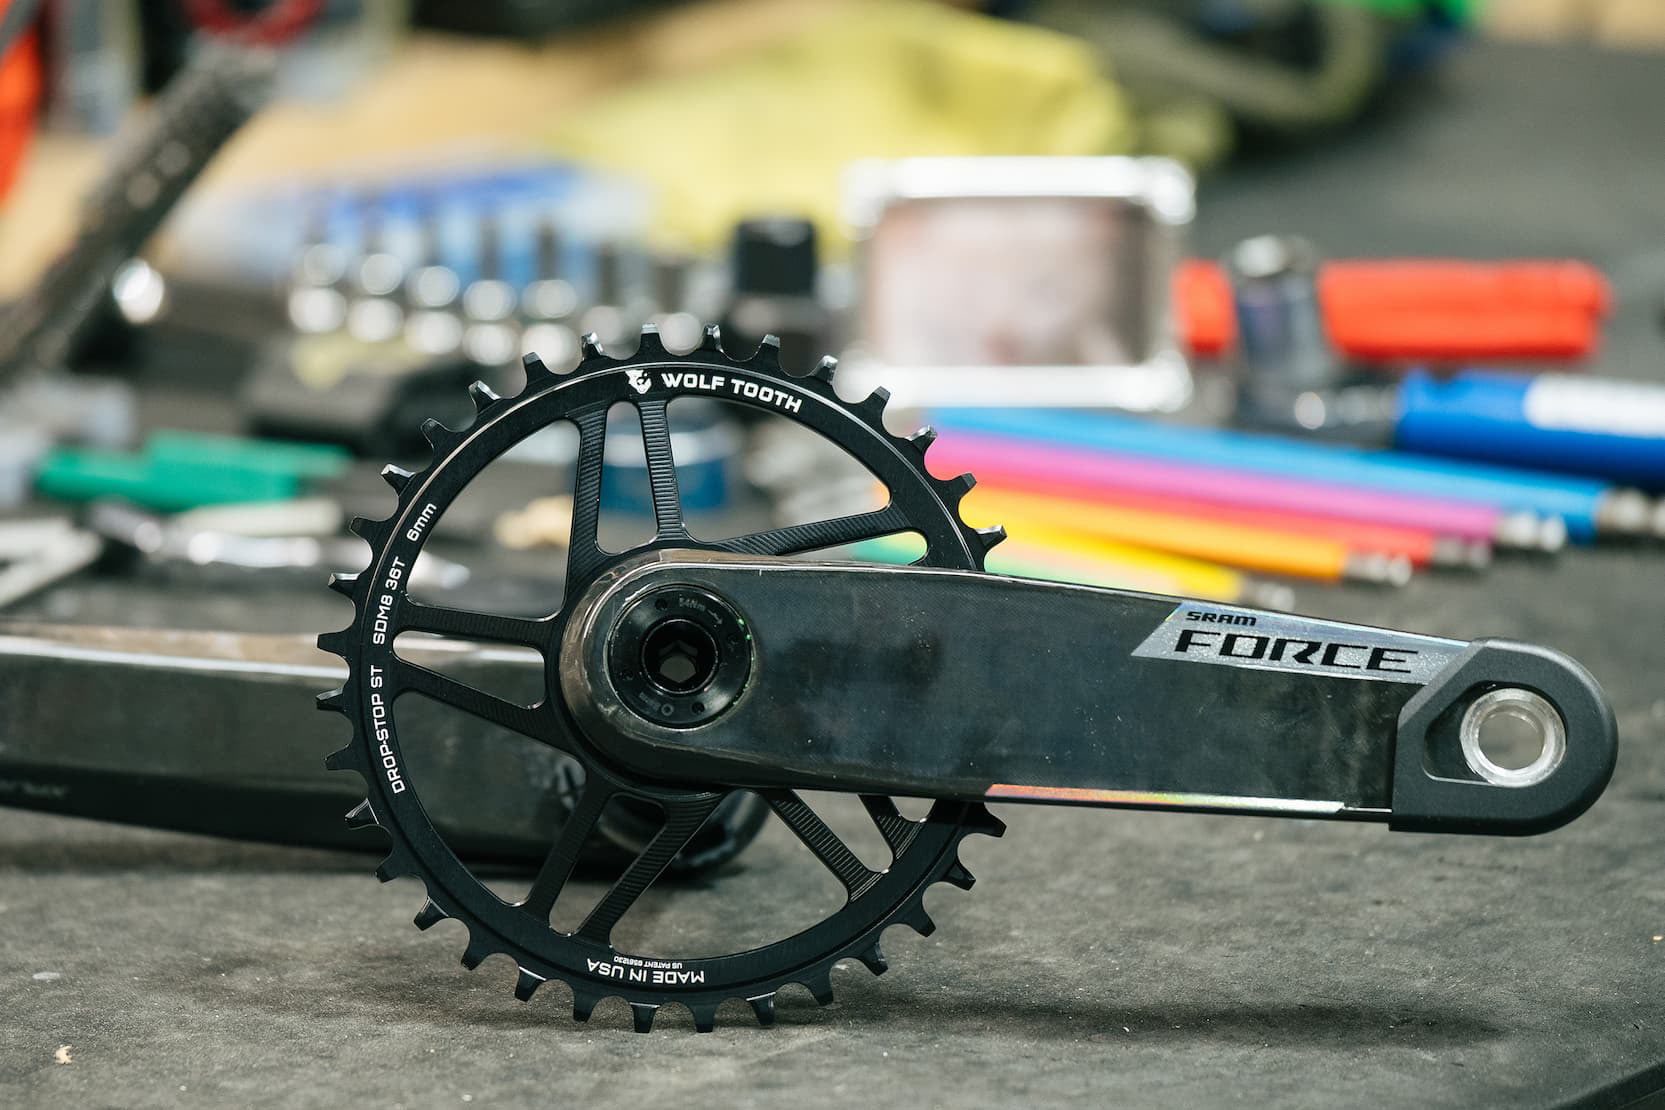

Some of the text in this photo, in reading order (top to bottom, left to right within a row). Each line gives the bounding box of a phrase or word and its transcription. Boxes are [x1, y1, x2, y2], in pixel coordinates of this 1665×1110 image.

[661, 373, 802, 412] WOLF TOOTH
[1185, 610, 1257, 627] SRAM
[370, 502, 437, 794] DROP-STOP ST SDM8 36T 6mm
[1174, 629, 1419, 673] FORCE
[587, 958, 705, 984] MADE IN USA
[644, 961, 672, 969] PATENT
